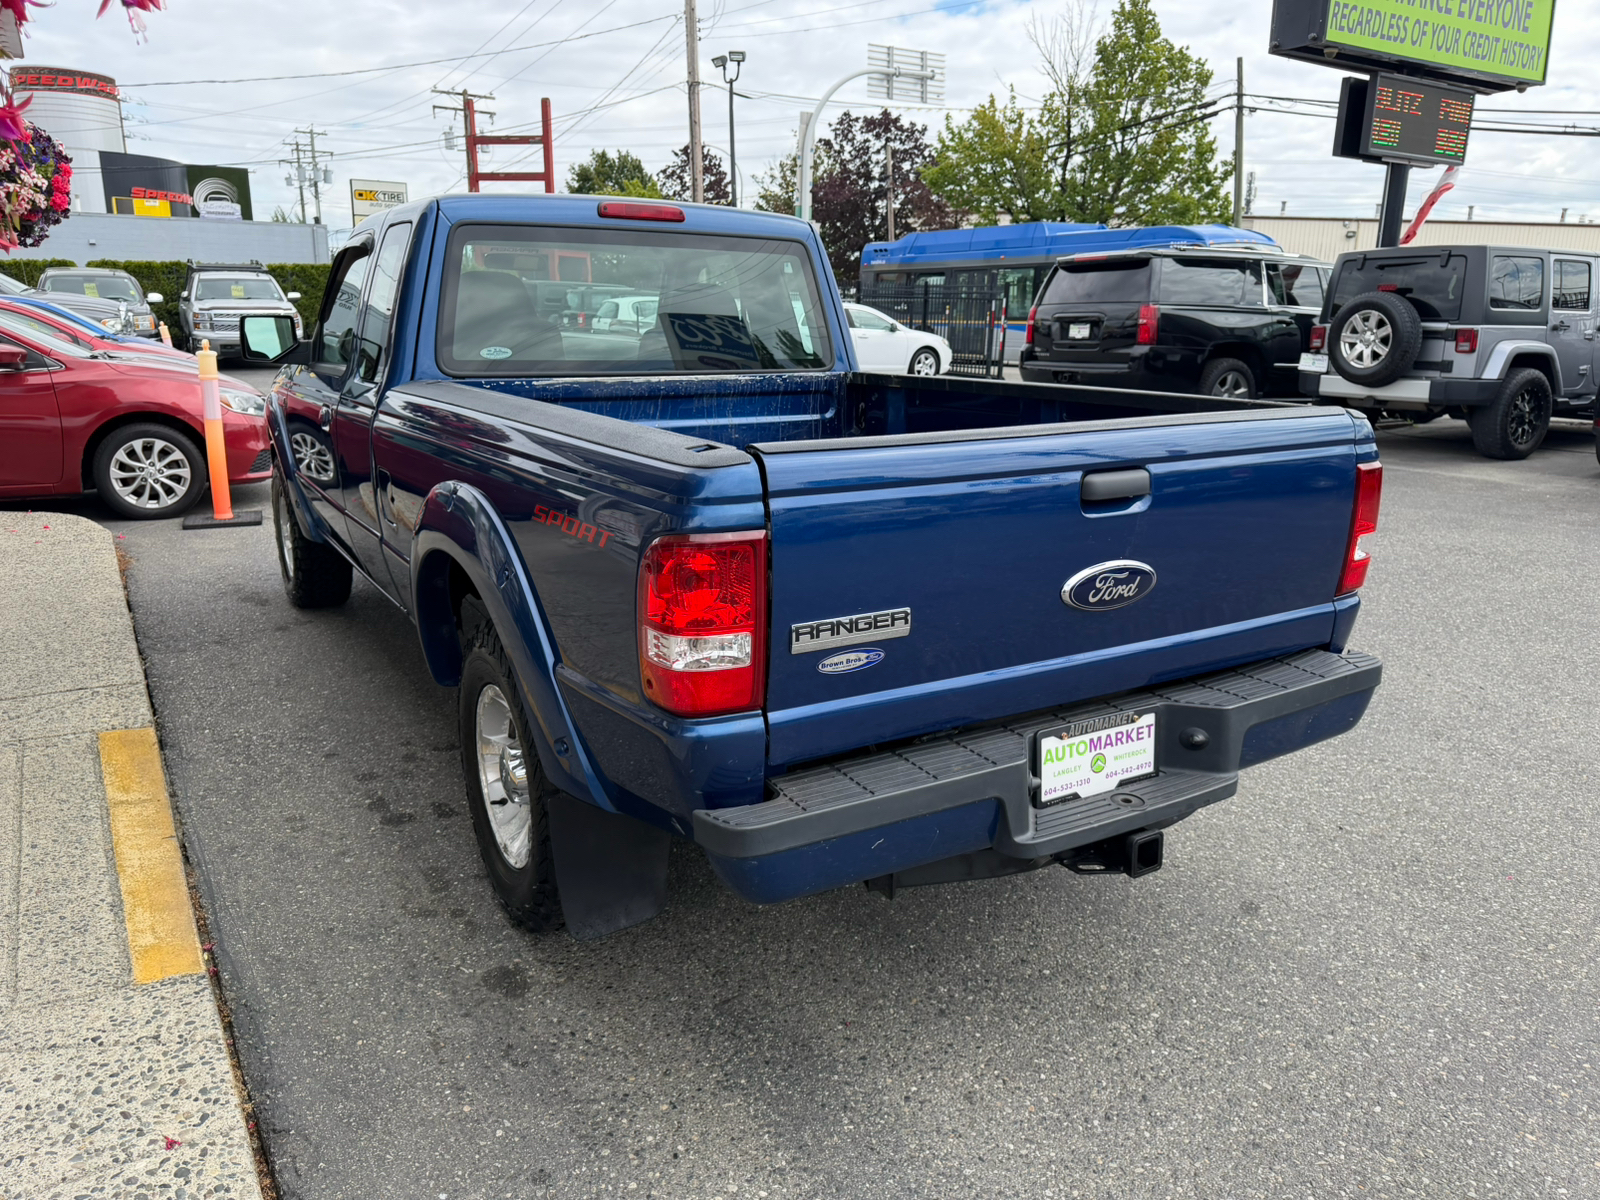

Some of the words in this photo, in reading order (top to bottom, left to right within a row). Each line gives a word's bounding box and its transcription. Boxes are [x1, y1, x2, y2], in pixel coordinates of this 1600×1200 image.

[1457, 0, 1534, 33] EVERYONE
[1329, 1, 1410, 44] REGARDLESS
[1411, 18, 1429, 47] OF
[1429, 22, 1462, 55] YOUR
[1463, 30, 1501, 62] CREDIT
[1499, 38, 1544, 72] HISTORY
[11, 73, 119, 96] PEEDWA
[354, 189, 379, 202] OK
[381, 192, 402, 201] TIRE
[532, 504, 615, 549] SPORT
[1088, 571, 1141, 603] Ford
[793, 610, 910, 643] RANGER
[821, 660, 844, 670] Brown
[846, 657, 864, 665] Bros.
[1069, 711, 1135, 738] AUTOMARKET
[1043, 723, 1154, 765] AUTOMARKET
[1113, 748, 1147, 761] WHITEROCK
[1053, 764, 1082, 778] LANGLEY
[1105, 761, 1152, 779] 604-542-4970
[1043, 777, 1091, 796] 604-533-1310
